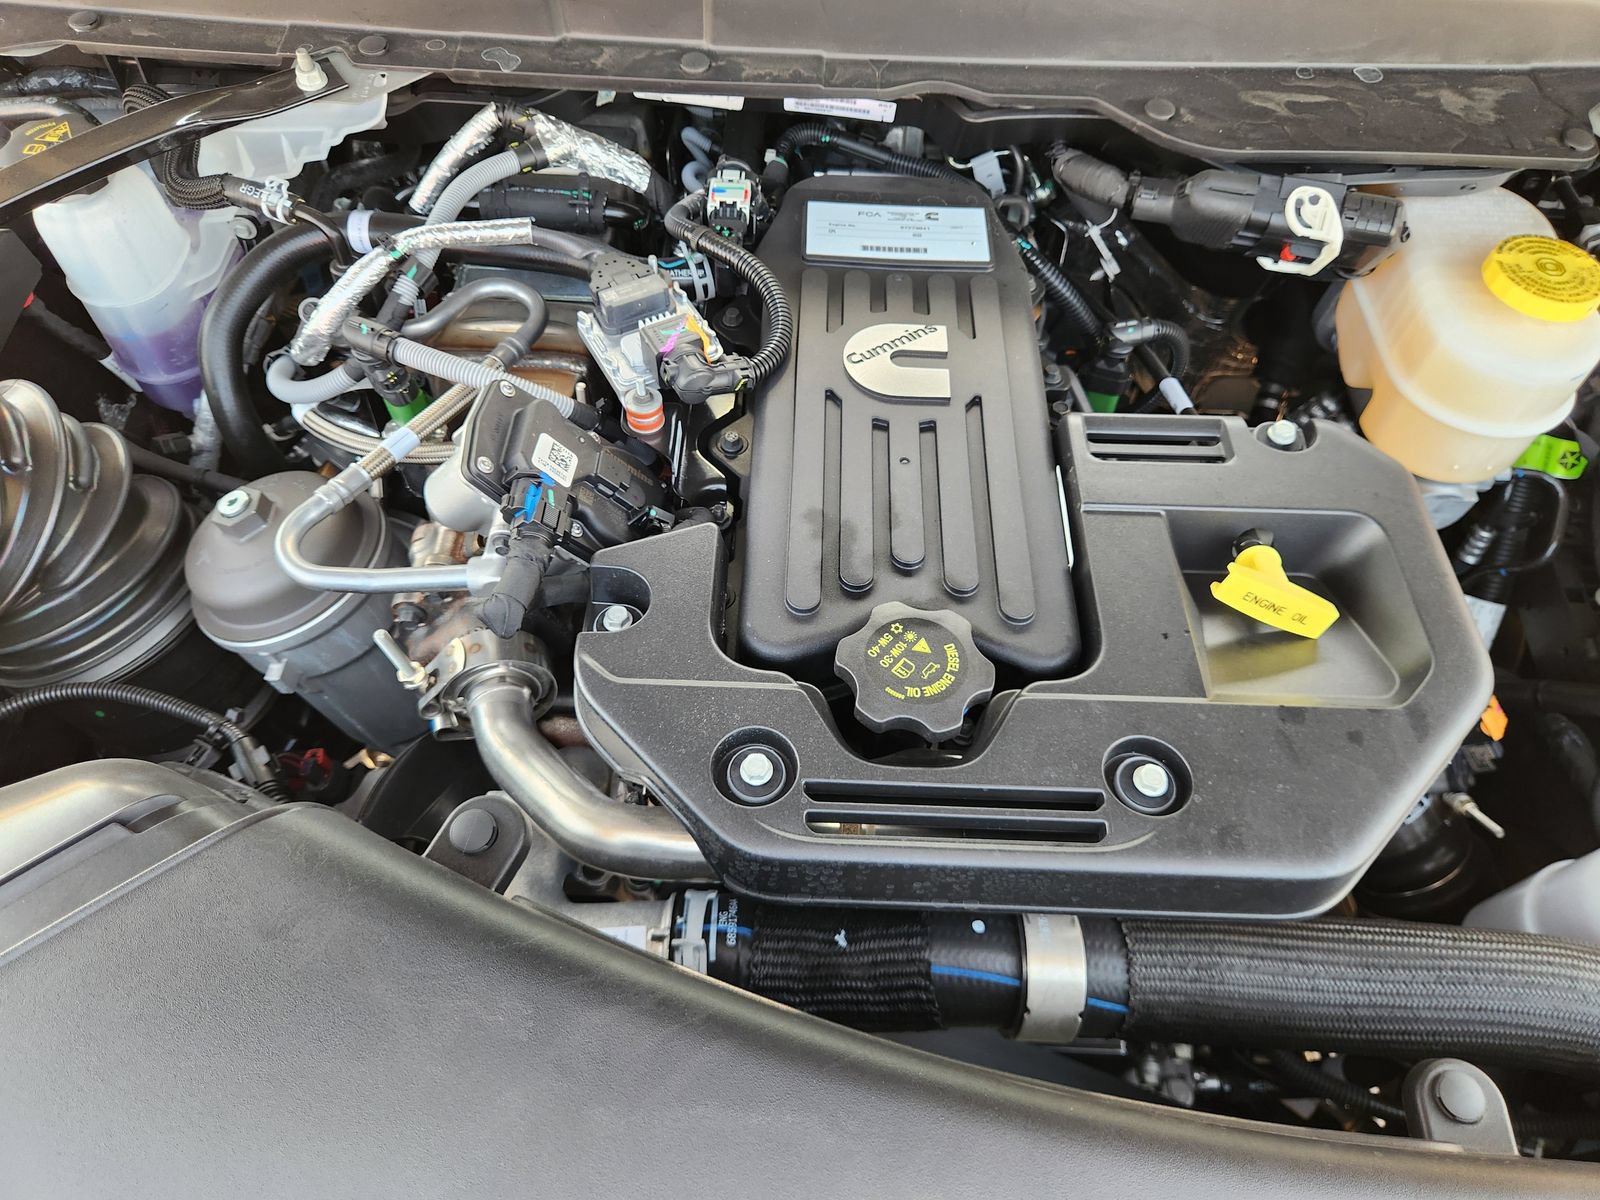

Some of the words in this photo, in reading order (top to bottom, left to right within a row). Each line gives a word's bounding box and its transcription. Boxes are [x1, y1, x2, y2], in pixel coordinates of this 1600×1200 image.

[857, 210, 882, 218] FCA
[846, 325, 939, 365] Cummins
[1242, 591, 1287, 616] ENGINE
[1290, 612, 1309, 626] OIL
[867, 632, 894, 658] 5W-40
[879, 641, 908, 669] 10W-30
[943, 643, 960, 672] DIESEL
[904, 686, 922, 698] OIL
[922, 673, 956, 698] ENGINE
[719, 911, 728, 927] ENG
